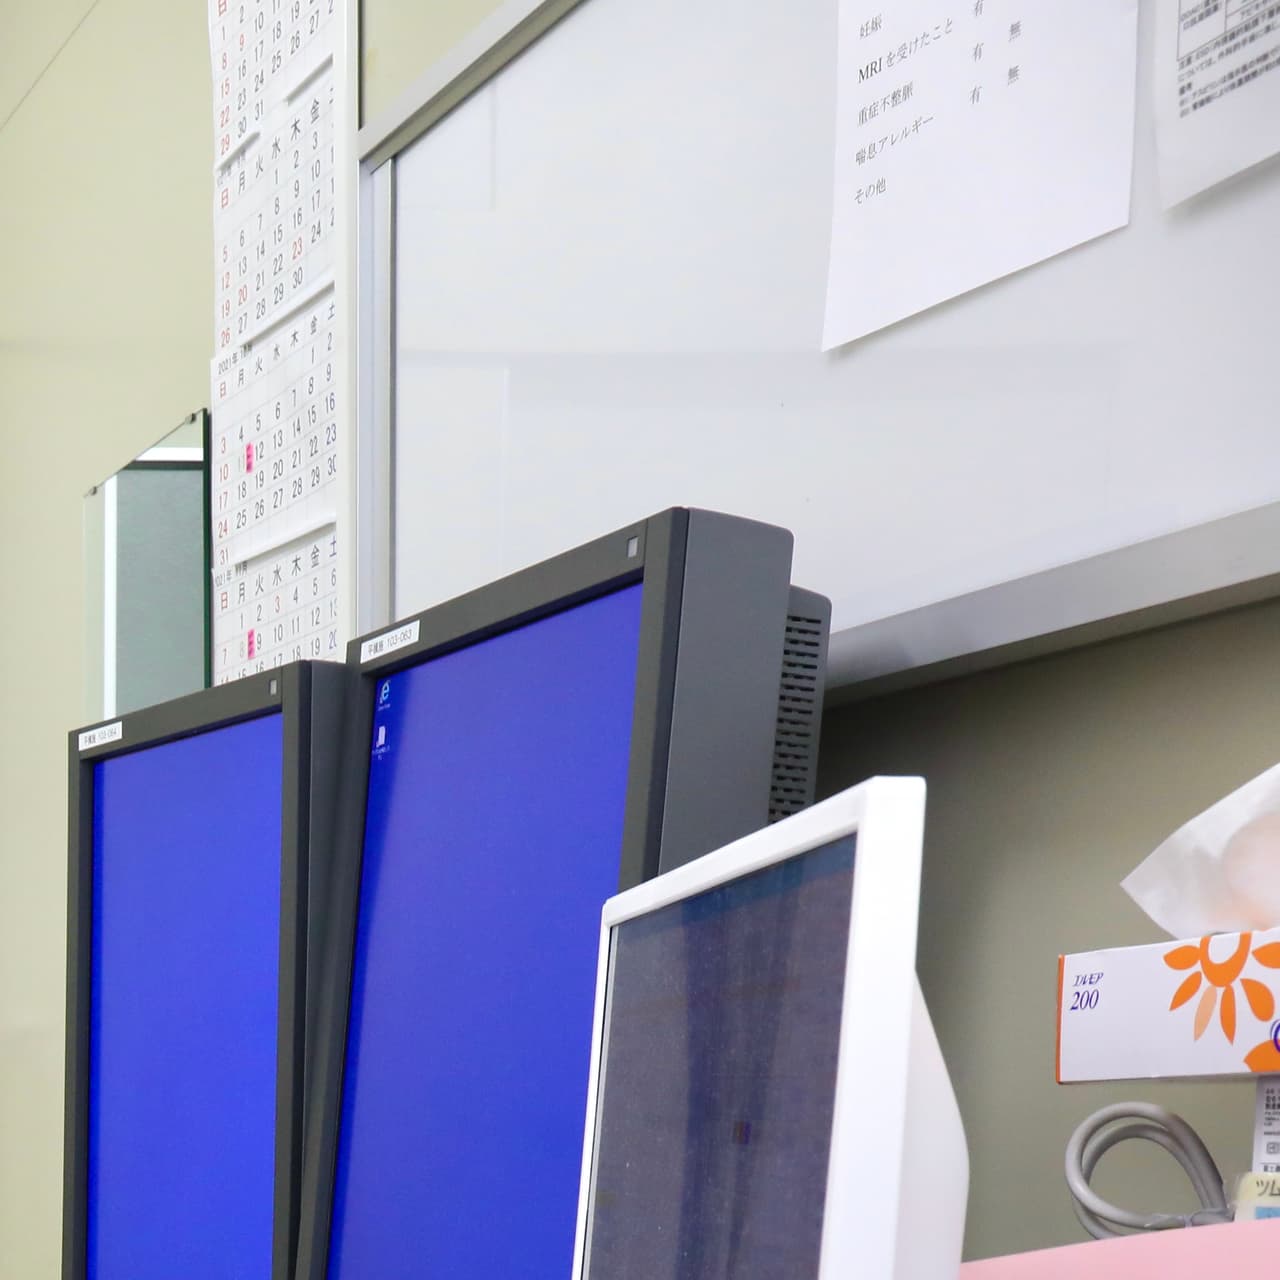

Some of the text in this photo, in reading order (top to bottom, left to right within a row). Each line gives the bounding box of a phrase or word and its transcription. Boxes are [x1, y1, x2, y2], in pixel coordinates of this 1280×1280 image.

[222, 52, 227, 70] 8
[239, 33, 245, 52] 9
[254, 11, 264, 33] 10
[239, 5, 244, 24] 2
[220, 9, 319, 129] 22 23 24 25 26 27
[221, 1, 300, 99] 15 16 17 18 19
[858, 18, 953, 83] MRI を受けたこと
[221, 133, 230, 156] 29
[238, 116, 247, 139] 30
[255, 99, 264, 121] 31
[221, 188, 229, 209] 日
[238, 170, 245, 195] 月
[255, 155, 264, 179] 火
[271, 136, 281, 160] 水
[291, 118, 300, 141] 木
[311, 99, 319, 124] 金
[294, 150, 299, 169] 2
[312, 131, 318, 150] 3
[223, 159, 320, 263] 5 6 7 8 9 10
[854, 177, 886, 204] その他
[221, 189, 320, 291] 12 13 14 15 16 17
[222, 219, 321, 319] 19 20 21 22 23 24
[221, 266, 303, 348] 26 27 28 29 30
[219, 381, 226, 399] 日
[238, 368, 244, 387] 月
[255, 357, 263, 376] 火
[290, 329, 299, 347] 木
[310, 315, 317, 335] 金
[327, 301, 335, 320] 土
[327, 332, 332, 351] 2
[219, 463, 229, 483] 10
[255, 441, 264, 462] 12
[273, 429, 283, 451] 13
[292, 417, 301, 438] 14
[307, 404, 317, 426] 15
[325, 391, 335, 414] 16
[221, 363, 331, 455] 3 4 5 6 7 8 9
[219, 423, 336, 511] 17 18 19 20 21 22 23
[218, 519, 228, 539] 24
[236, 509, 247, 529] 25
[255, 499, 265, 519] 26
[273, 488, 284, 509] 27
[292, 477, 303, 499] 28
[311, 466, 320, 488] 29
[220, 548, 229, 566] 31
[220, 591, 228, 610] 日
[238, 582, 245, 604] 月
[255, 573, 264, 596] 火
[273, 564, 282, 586] 水
[292, 554, 301, 576] 木
[311, 544, 320, 568] 金
[257, 604, 262, 622] 2
[274, 595, 280, 613] 3
[293, 586, 298, 604] 4
[312, 577, 318, 596] 5
[222, 648, 227, 665] 7
[256, 633, 262, 650] 9
[273, 623, 283, 643] 10
[292, 616, 300, 635] 11
[311, 607, 320, 627] 12
[311, 637, 320, 657] 19
[1070, 988, 1100, 1011] 200
